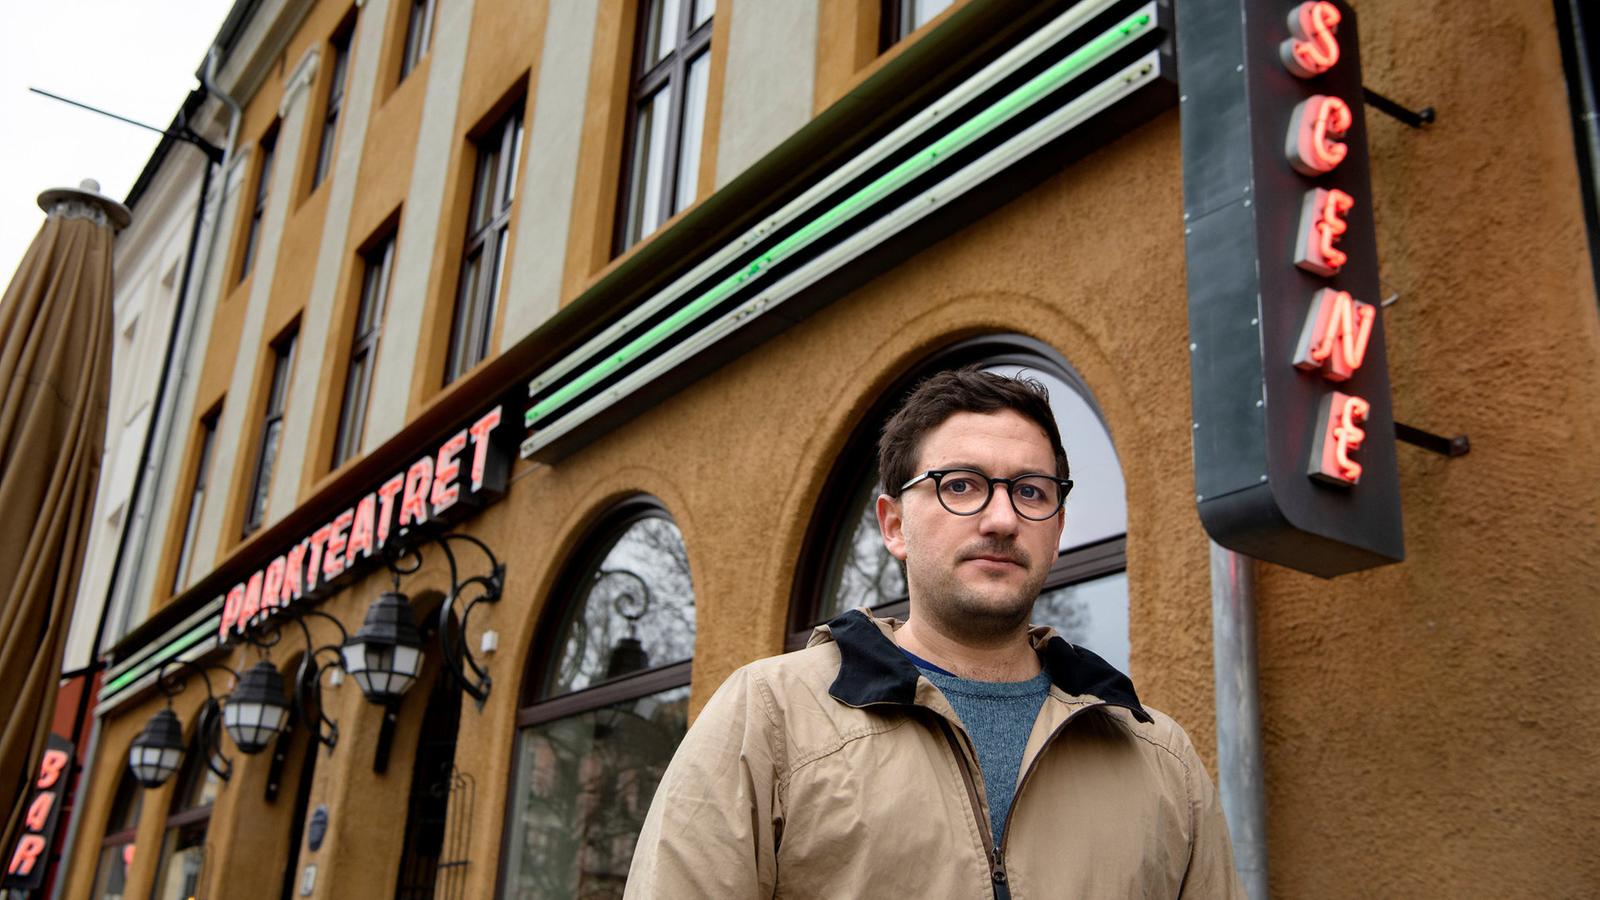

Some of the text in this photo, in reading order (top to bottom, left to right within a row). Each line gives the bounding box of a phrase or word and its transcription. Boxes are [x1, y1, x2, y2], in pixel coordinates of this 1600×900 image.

[1280, 1, 1376, 486] SCENE
[219, 405, 502, 644] PARKTEATRET
[8, 749, 68, 875] BAR
